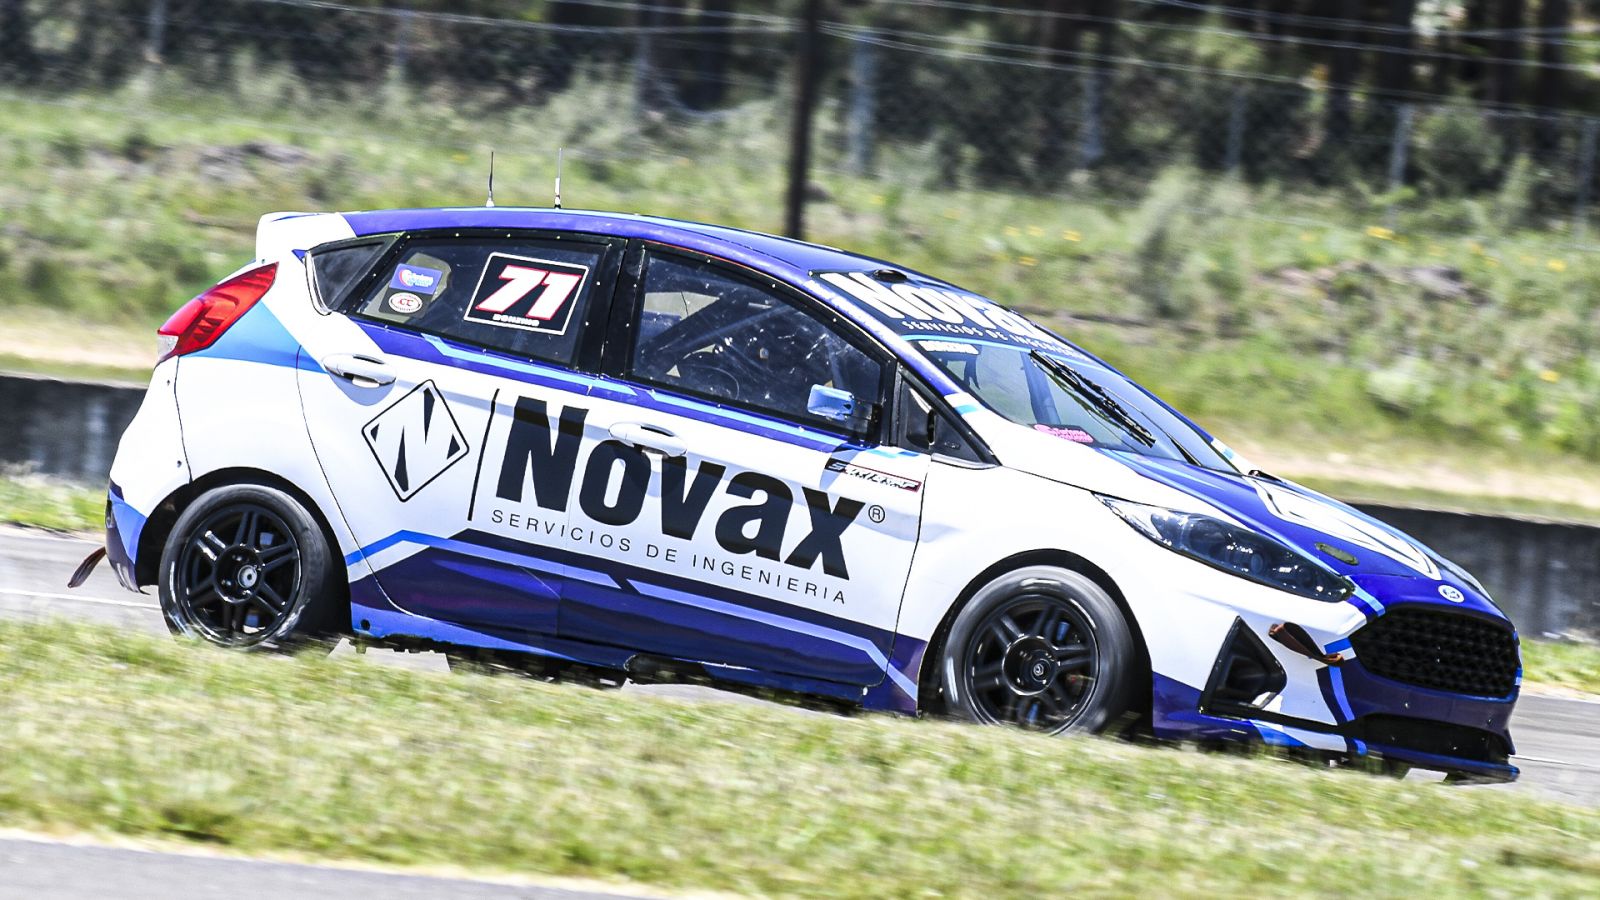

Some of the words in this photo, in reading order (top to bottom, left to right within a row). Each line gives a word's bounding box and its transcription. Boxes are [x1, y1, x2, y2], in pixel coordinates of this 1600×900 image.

[475, 264, 582, 320] 71
[901, 321, 983, 337] SERVICIOS
[496, 395, 866, 580] Novax
[491, 509, 631, 552] SERVICIOS
[646, 544, 677, 563] DE
[692, 554, 845, 604] INGENIERIA
